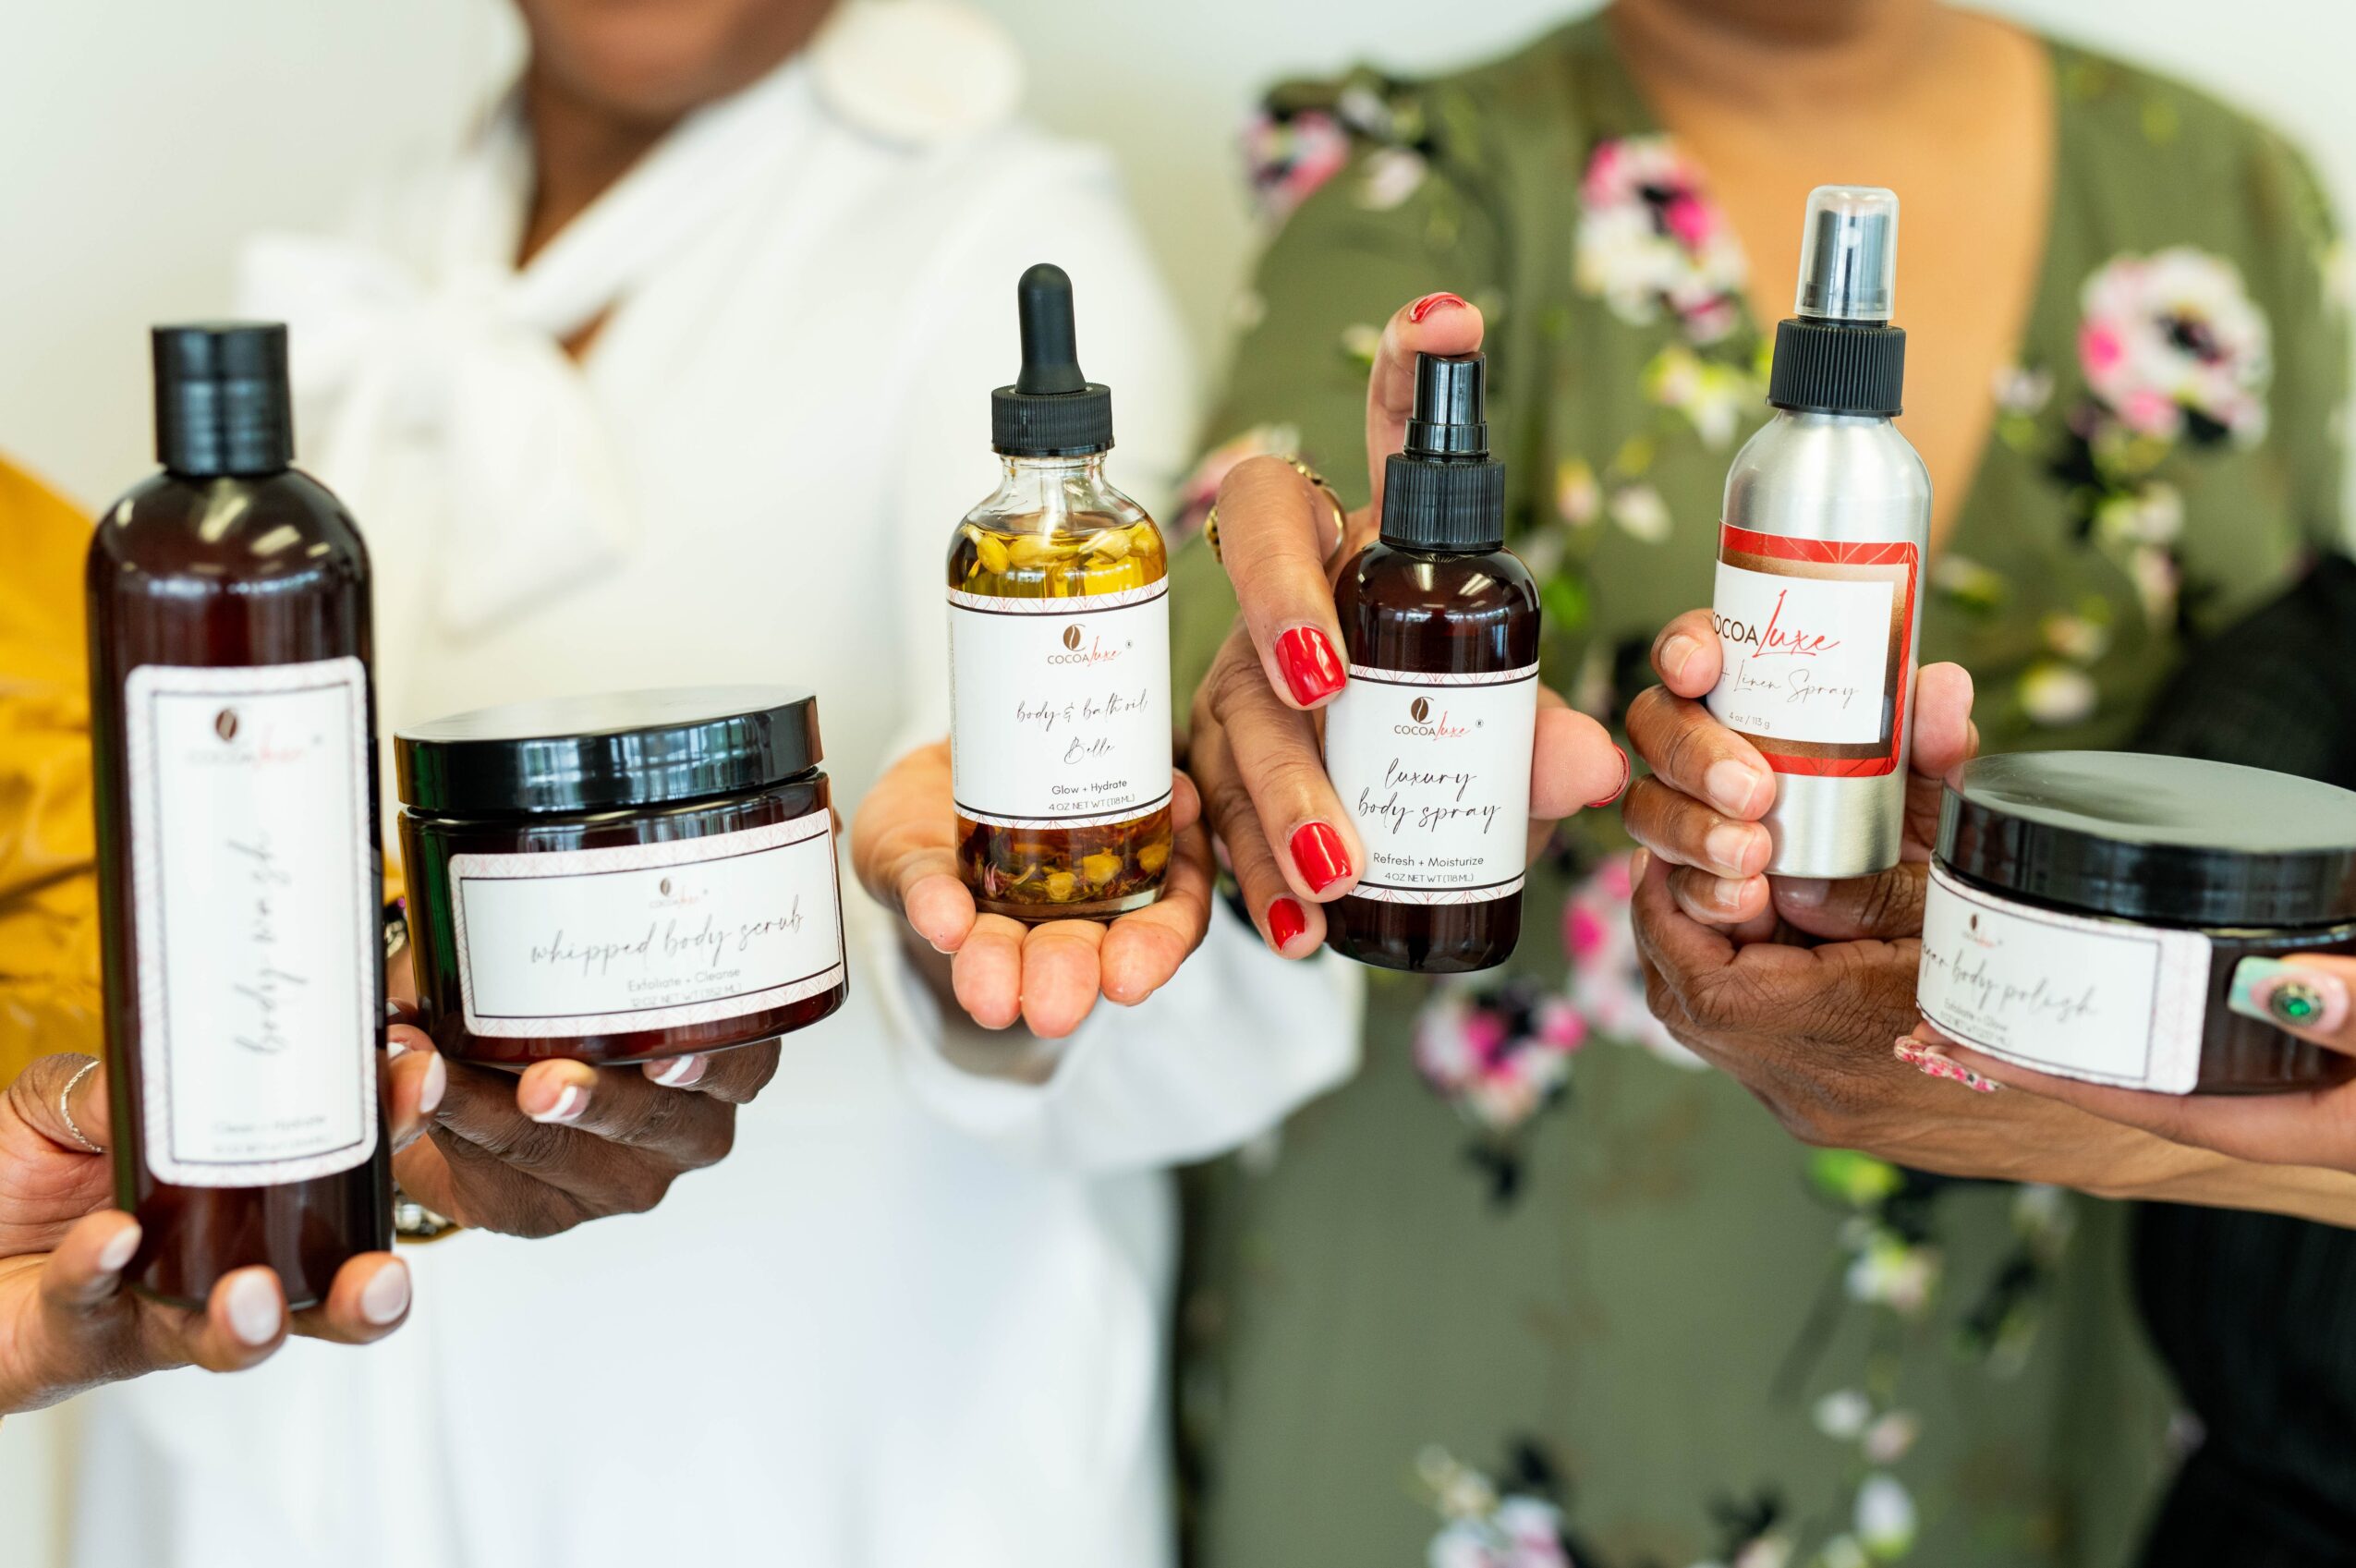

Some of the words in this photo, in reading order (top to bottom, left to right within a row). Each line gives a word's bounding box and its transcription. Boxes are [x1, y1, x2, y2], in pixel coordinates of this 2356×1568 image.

[1734, 659, 1781, 692] Linen
[1787, 668, 1860, 710] Spray
[1016, 700, 1061, 732] body
[1083, 692, 1123, 722] bath
[1051, 784, 1079, 796] Glow
[1090, 780, 1127, 794] Hydrate
[1385, 758, 1477, 802] luxury
[1049, 803, 1055, 811] 4
[1056, 803, 1071, 811] OZ
[1072, 801, 1089, 810] NET
[1358, 786, 1415, 834] body
[1418, 805, 1501, 834] spray
[1373, 852, 1415, 866] Refresh
[1427, 857, 1484, 867] Moisturize
[1392, 873, 1405, 881] OZ
[1407, 874, 1425, 882] NET
[530, 921, 658, 977] whipped
[663, 914, 733, 967] body
[739, 894, 805, 952] scrub
[695, 968, 741, 983] Cleanse
